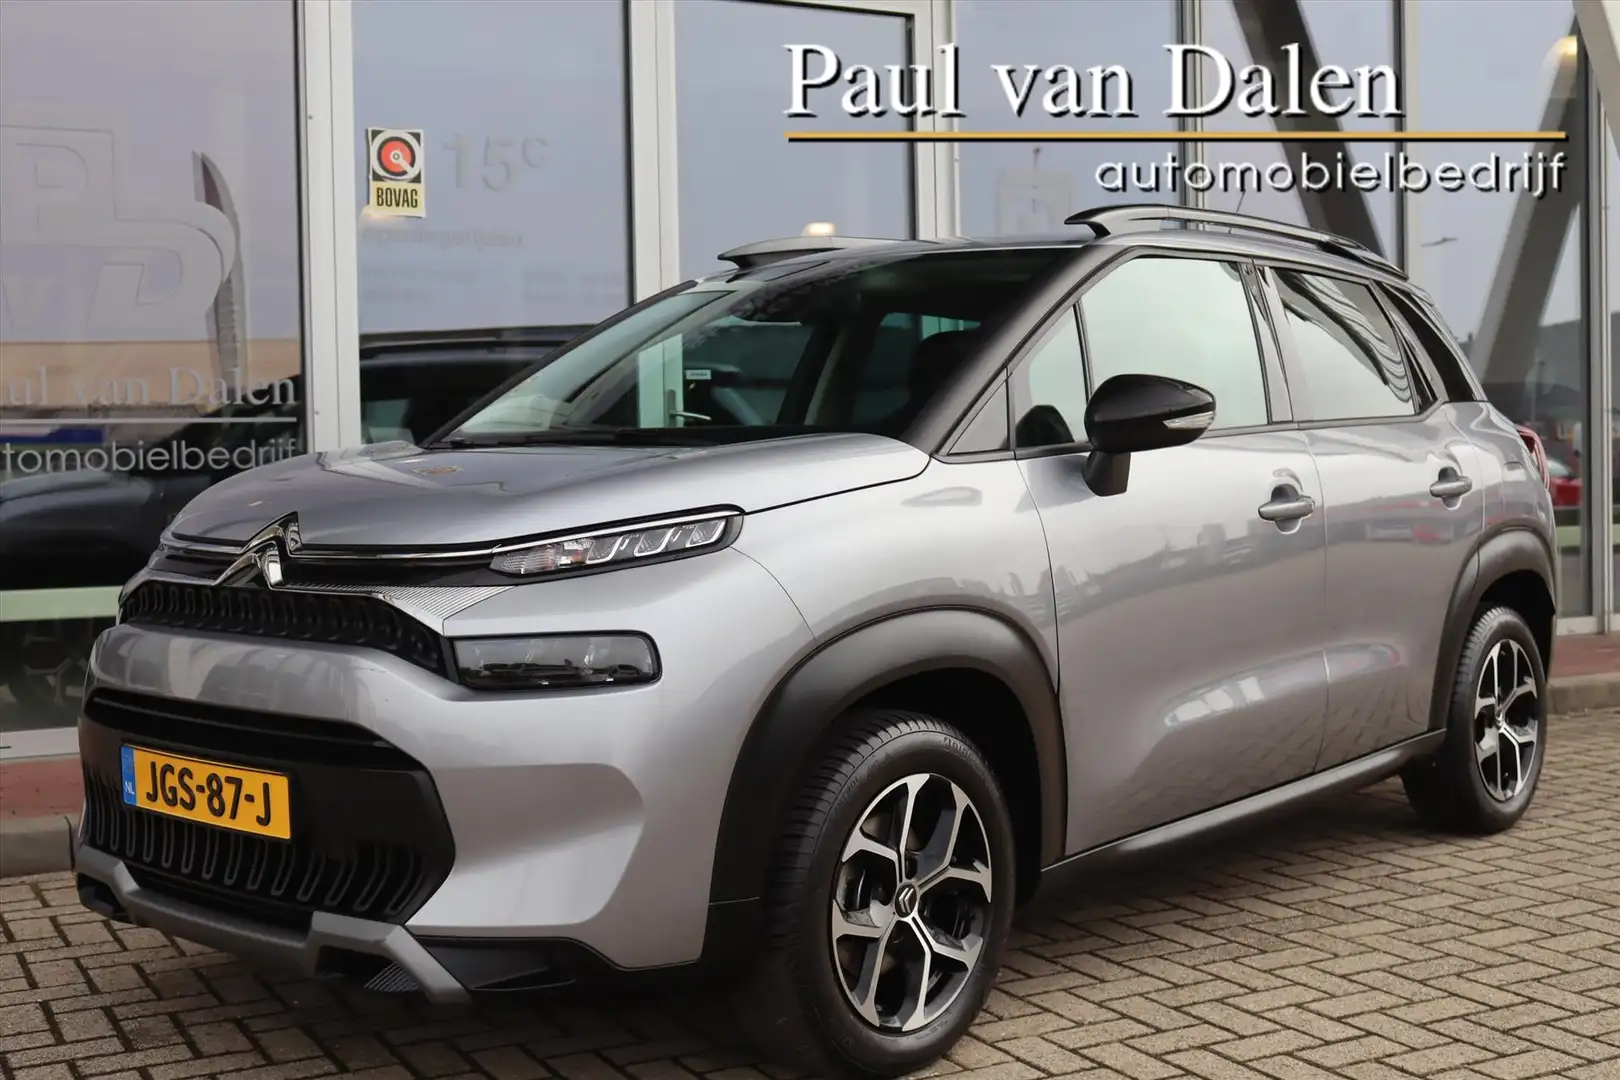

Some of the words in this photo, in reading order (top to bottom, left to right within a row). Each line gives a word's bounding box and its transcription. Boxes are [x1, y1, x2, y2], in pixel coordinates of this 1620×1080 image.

[376, 187, 419, 209] BOVAG
[69, 376, 151, 405] van
[168, 366, 297, 405] Dalen
[124, 779, 135, 795] NL
[146, 761, 271, 827] JGS-87-J
